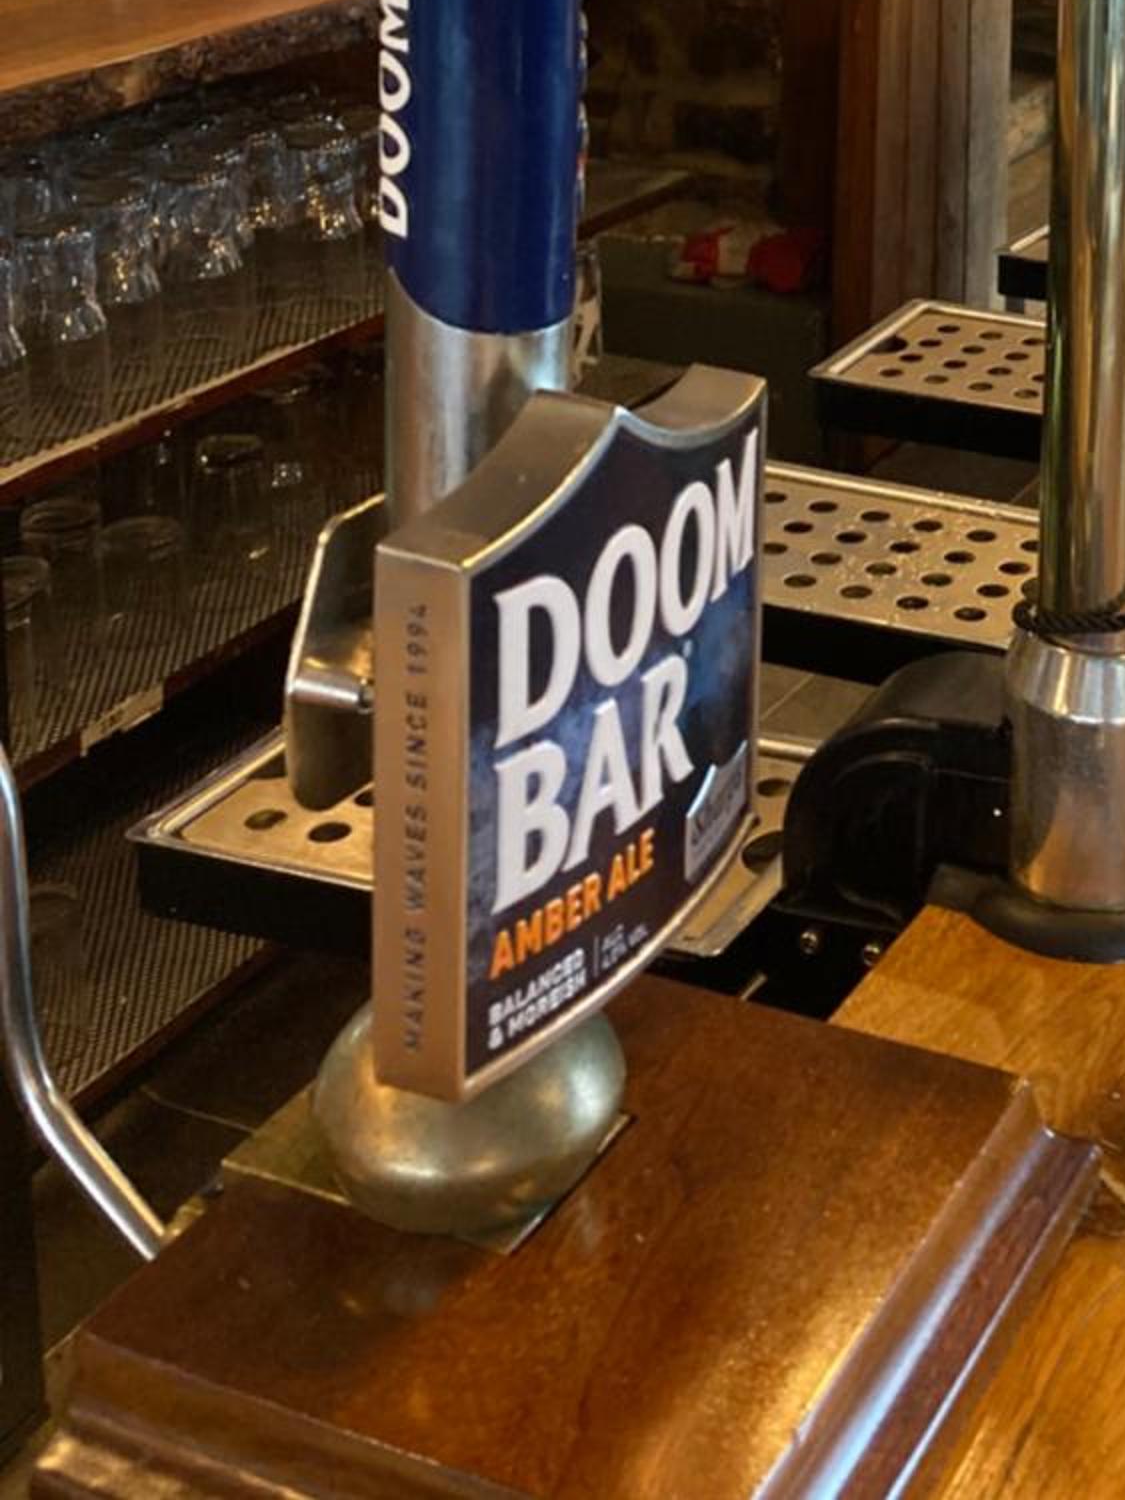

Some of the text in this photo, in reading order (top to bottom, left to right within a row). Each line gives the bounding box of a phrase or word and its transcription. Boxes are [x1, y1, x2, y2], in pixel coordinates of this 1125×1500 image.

[493, 427, 758, 750] DOOM
[404, 602, 429, 1056] MAKING WAVES SINCE 1994
[489, 648, 694, 916] BAR
[487, 967, 587, 1050] & MOREISH
[488, 827, 656, 981] AMBER ALE
[488, 947, 585, 1027] BALANCED
